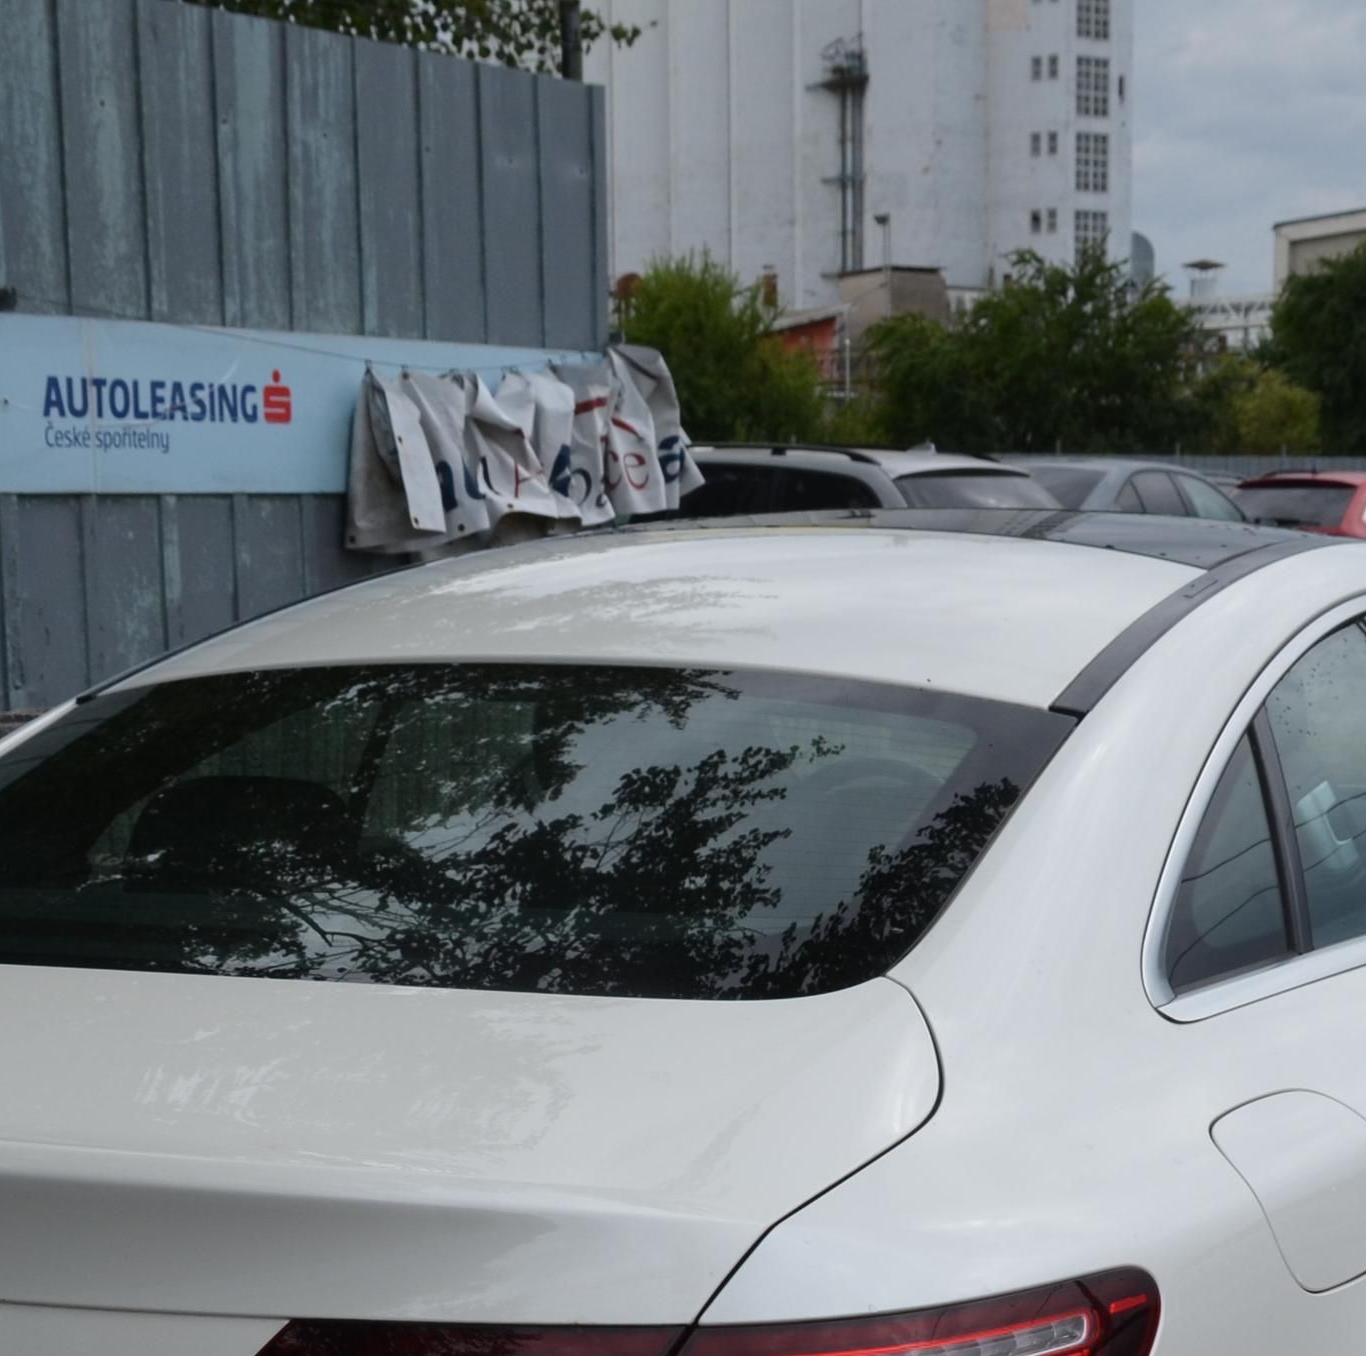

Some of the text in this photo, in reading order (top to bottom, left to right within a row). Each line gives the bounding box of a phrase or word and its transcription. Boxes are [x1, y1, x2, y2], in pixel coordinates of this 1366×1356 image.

[42, 375, 258, 424] AUTOLEASING
[44, 420, 170, 454] České spořitelny
